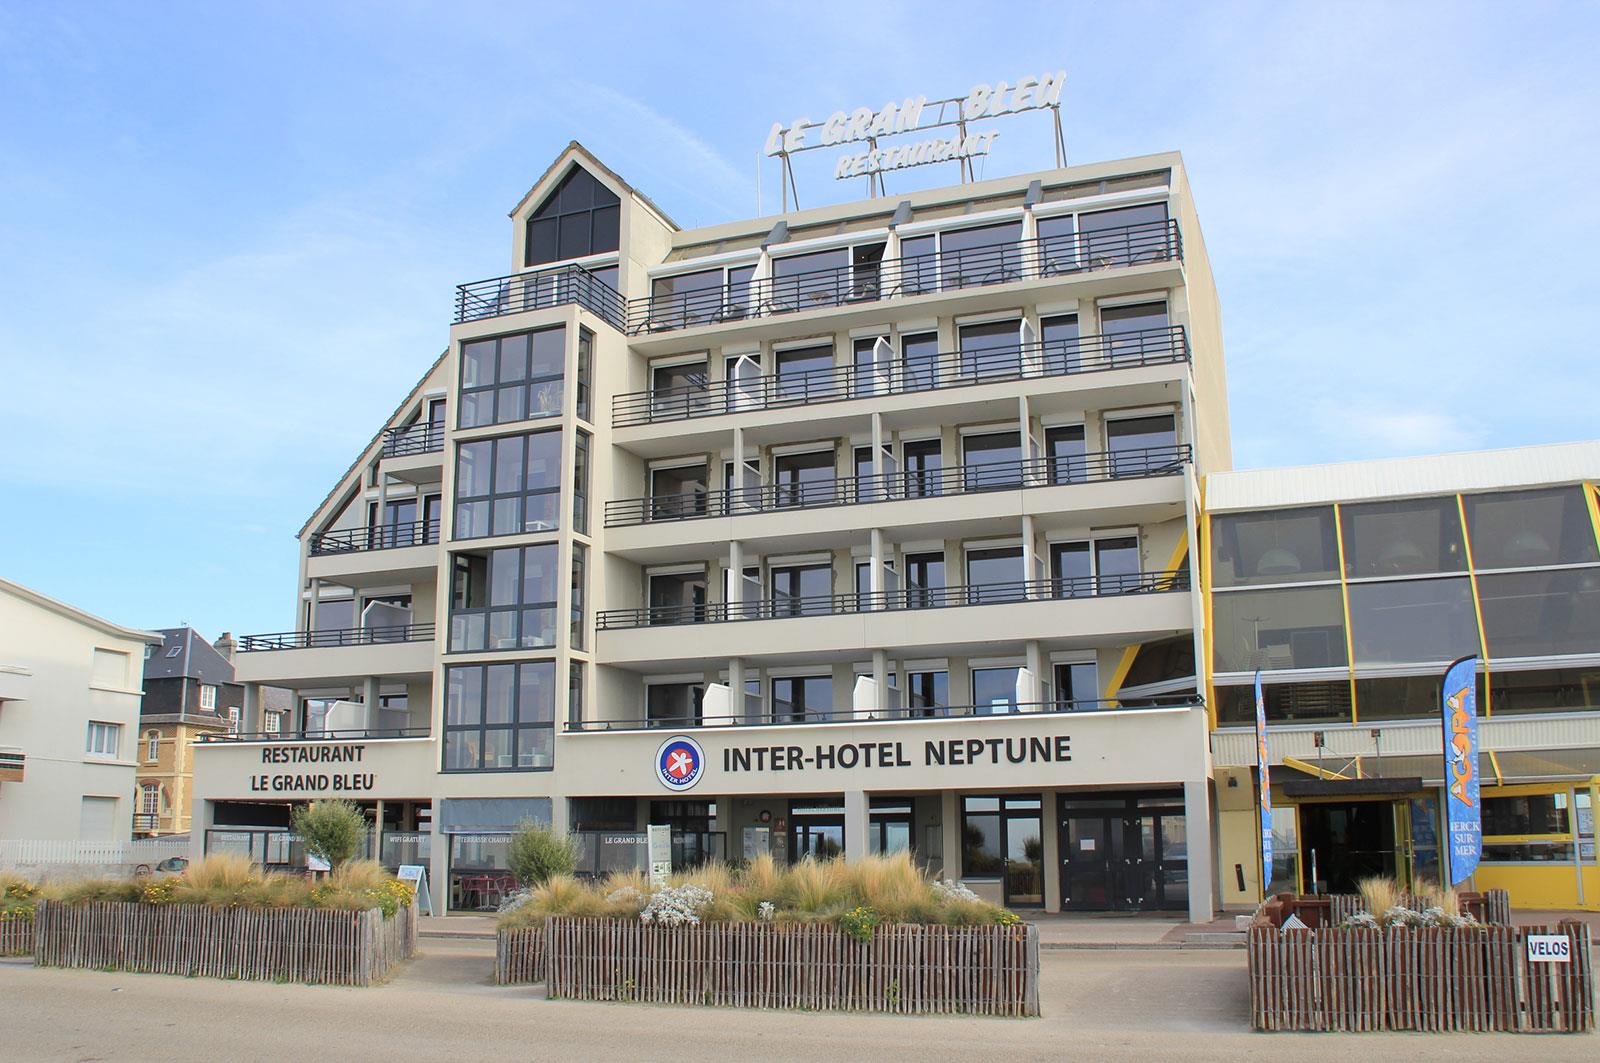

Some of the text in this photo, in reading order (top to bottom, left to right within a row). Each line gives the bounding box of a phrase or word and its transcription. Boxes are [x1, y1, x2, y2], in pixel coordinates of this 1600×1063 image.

[763, 69, 1067, 156] LE GRAN BLEU
[835, 129, 1000, 180] RESTAURANT
[262, 745, 365, 763] RESTAURANT
[723, 735, 1071, 773] INTER-HOTEL NEPTUNE
[272, 774, 329, 791] GRAND
[662, 767, 698, 784] INTER HOTEL
[1455, 833, 1475, 844] SUR
[1454, 845, 1478, 856] MER
[1530, 941, 1568, 956] VELOS
